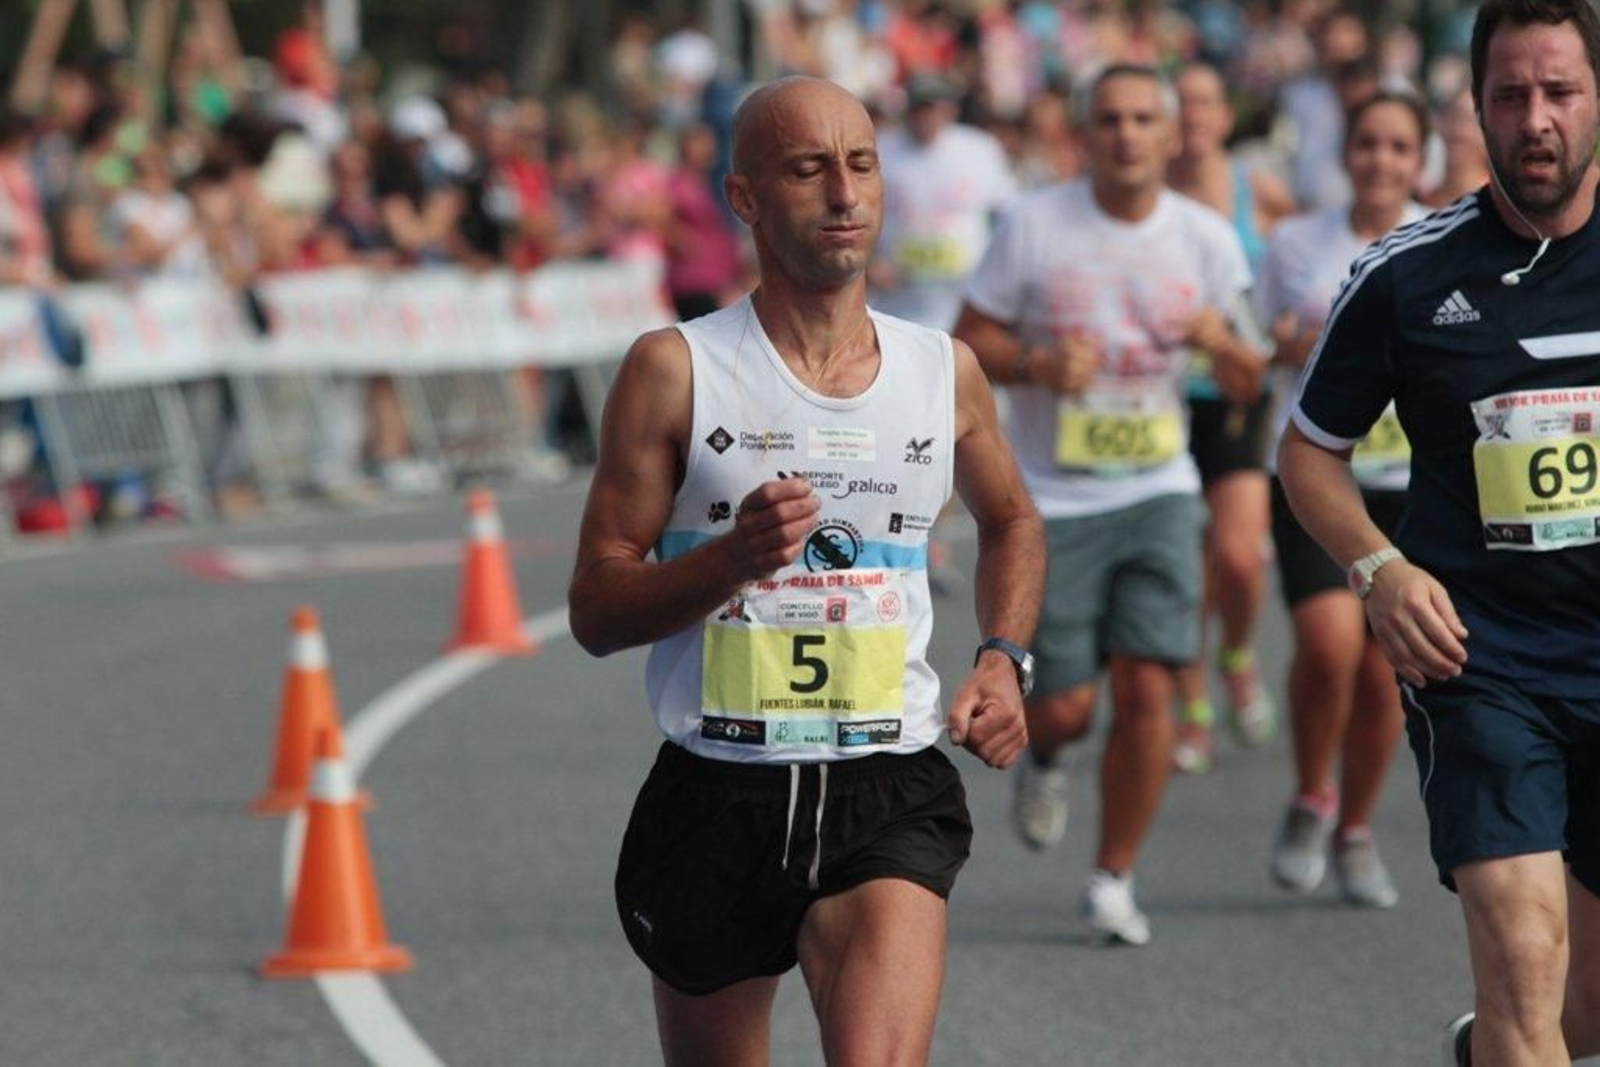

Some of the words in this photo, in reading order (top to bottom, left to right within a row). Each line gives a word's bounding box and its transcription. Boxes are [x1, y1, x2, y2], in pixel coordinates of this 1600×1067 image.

[1433, 310, 1481, 325] adidas
[904, 453, 932, 465] ZICO
[1529, 443, 1597, 499] 69
[831, 478, 898, 499] galicia
[827, 574, 844, 586] DE
[780, 602, 824, 610] CONCELLO
[785, 611, 796, 619] DE
[798, 611, 819, 619] VIGO
[790, 635, 829, 693] 5
[760, 699, 795, 710] FUENTES
